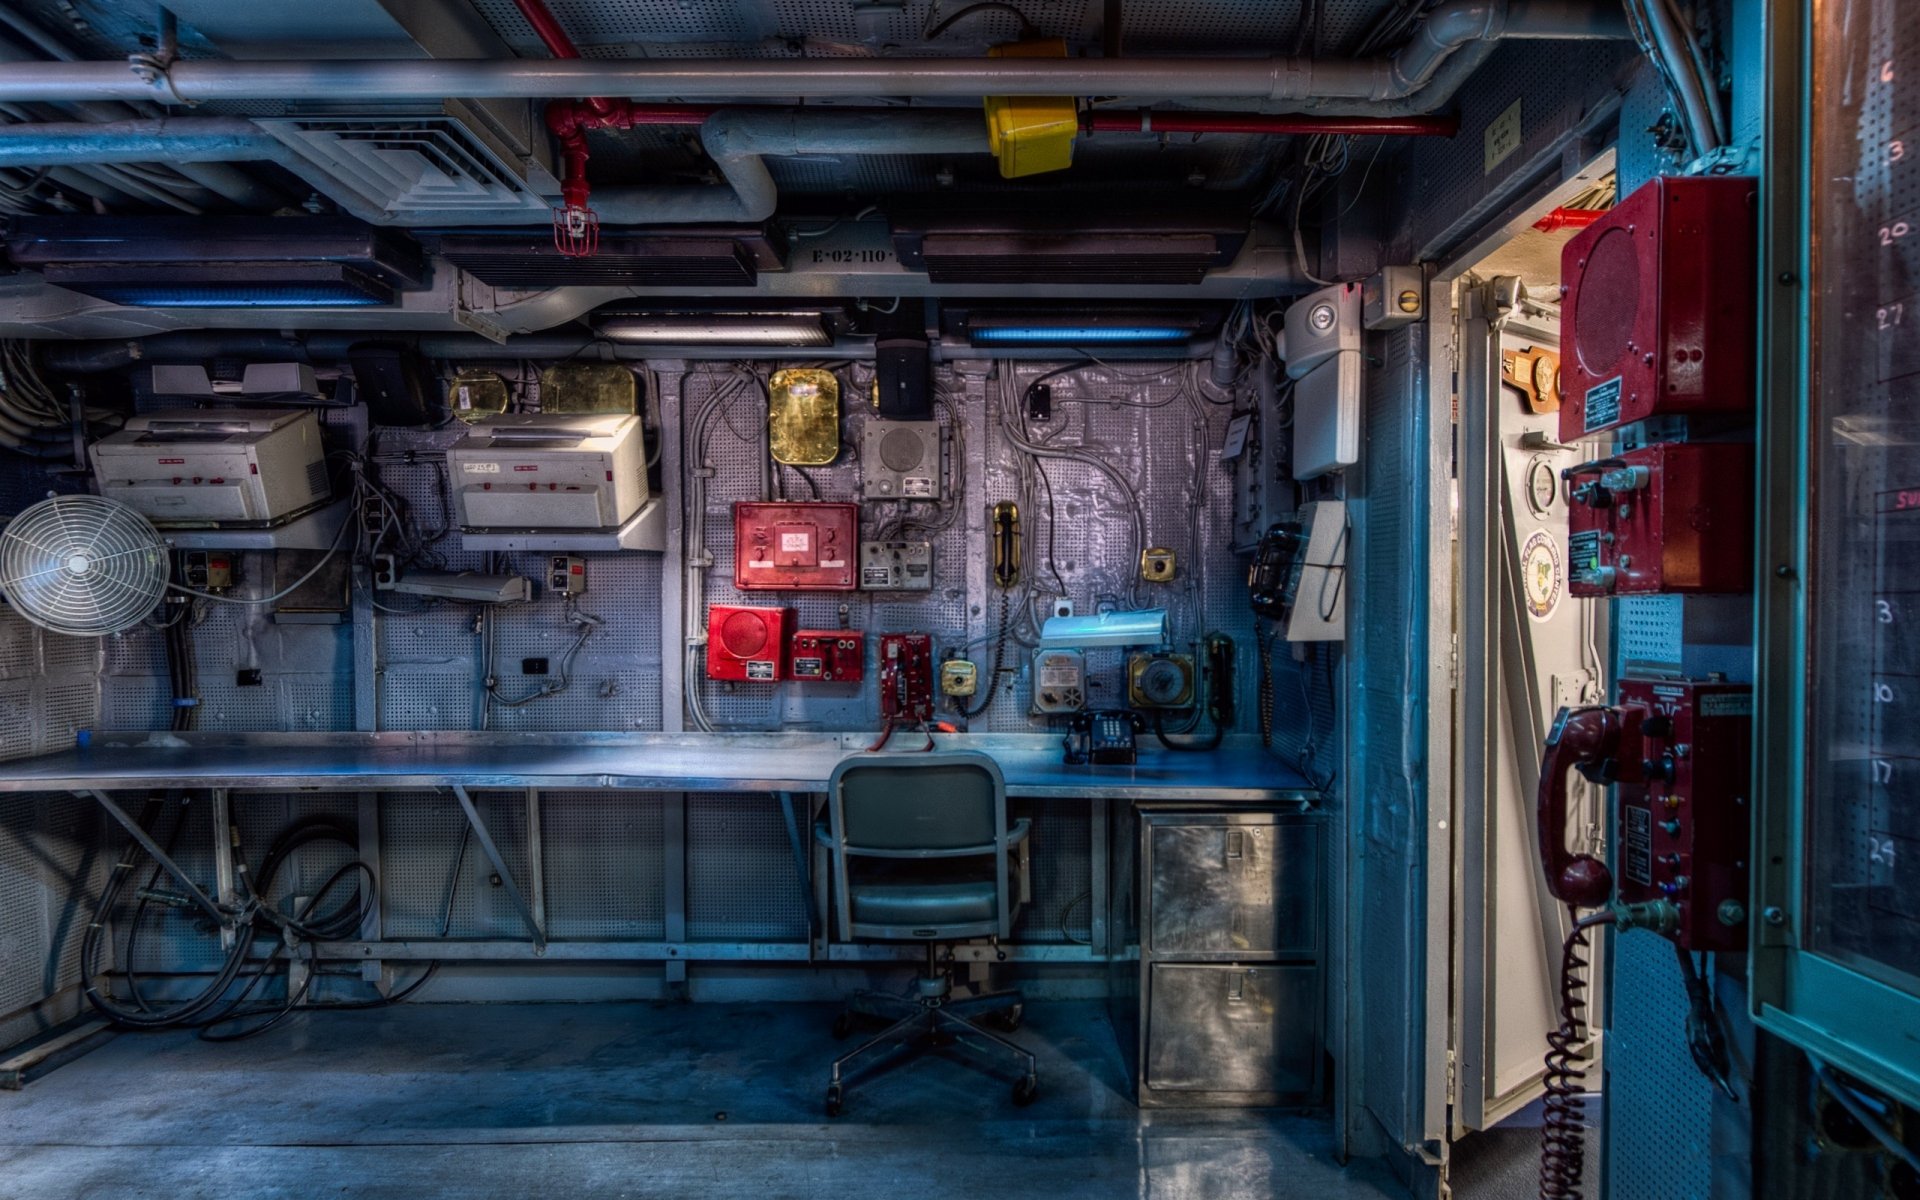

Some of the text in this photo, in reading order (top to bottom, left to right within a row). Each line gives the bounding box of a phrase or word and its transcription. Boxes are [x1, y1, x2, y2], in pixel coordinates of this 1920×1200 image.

[1881, 60, 1894, 82] 6
[1878, 222, 1908, 246] 20
[1876, 303, 1903, 330] 27
[1896, 490, 1920, 509] SU
[1877, 600, 1893, 623] 3
[1874, 682, 1894, 702] 10
[1872, 760, 1891, 784] 17
[1870, 837, 1896, 867] 24
